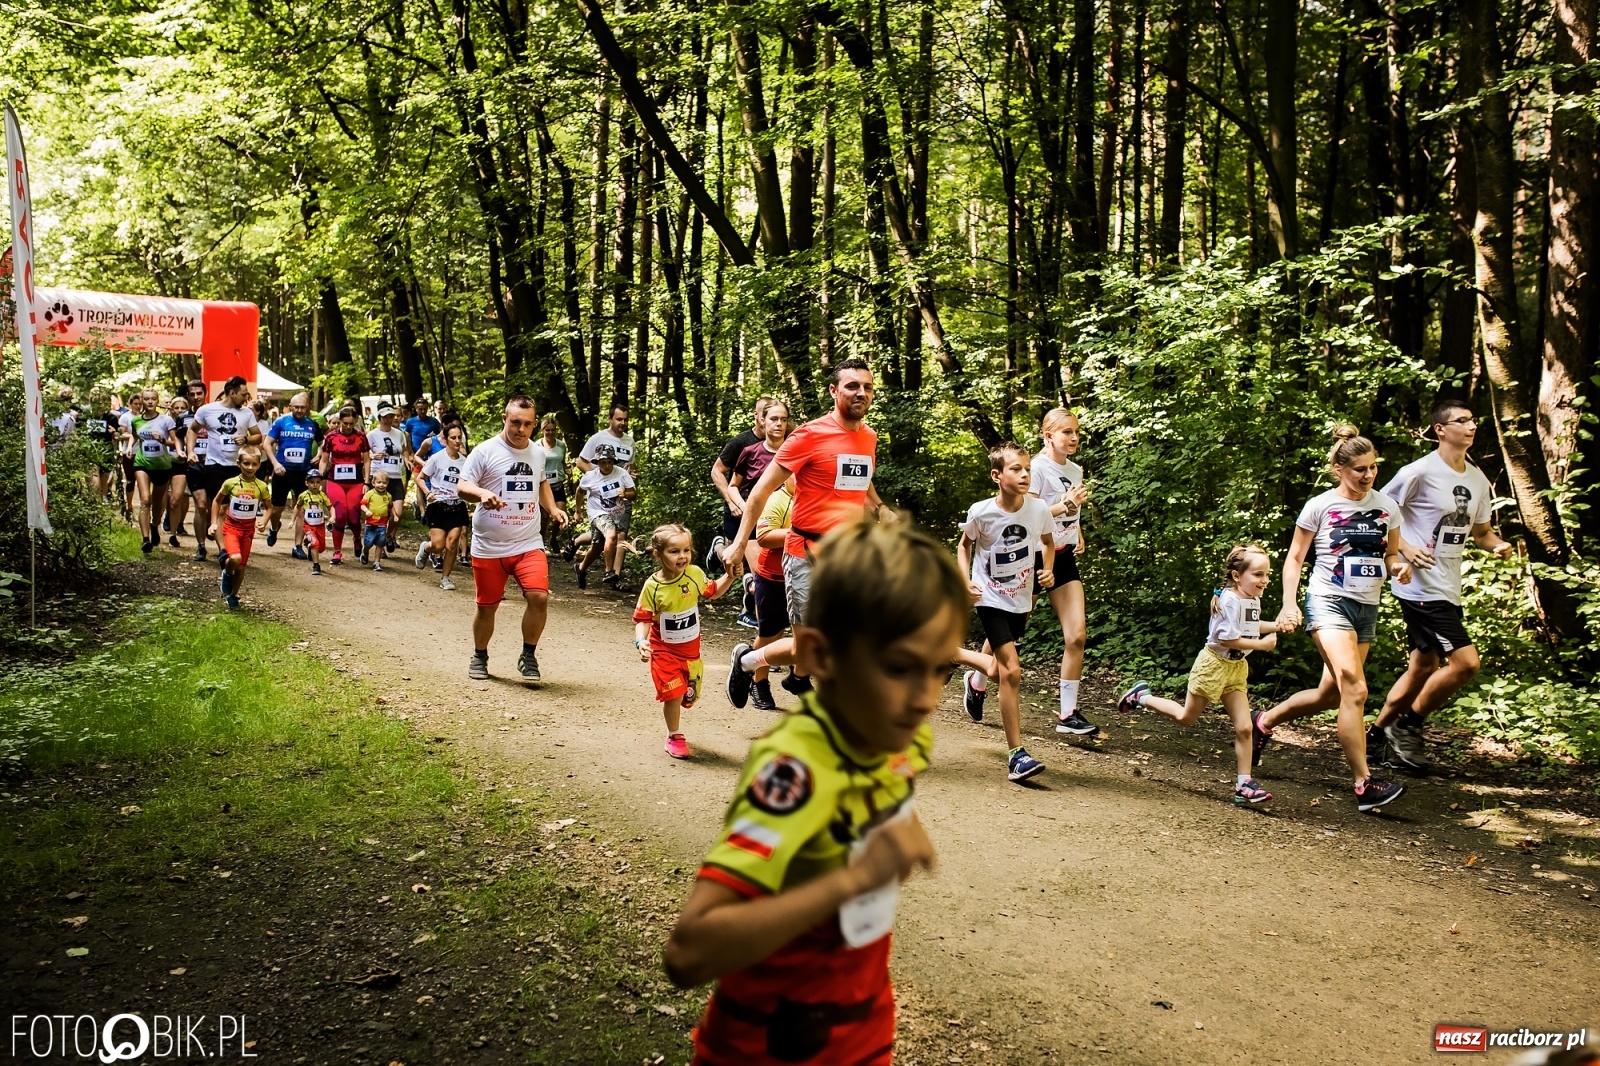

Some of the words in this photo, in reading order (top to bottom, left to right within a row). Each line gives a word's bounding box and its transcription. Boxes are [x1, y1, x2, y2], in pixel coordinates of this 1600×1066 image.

[849, 465, 861, 475] 76
[514, 482, 527, 490] 23
[1453, 534, 1460, 543] 5
[1008, 552, 1017, 562] 9
[1360, 565, 1376, 576] 63
[674, 616, 690, 629] 77
